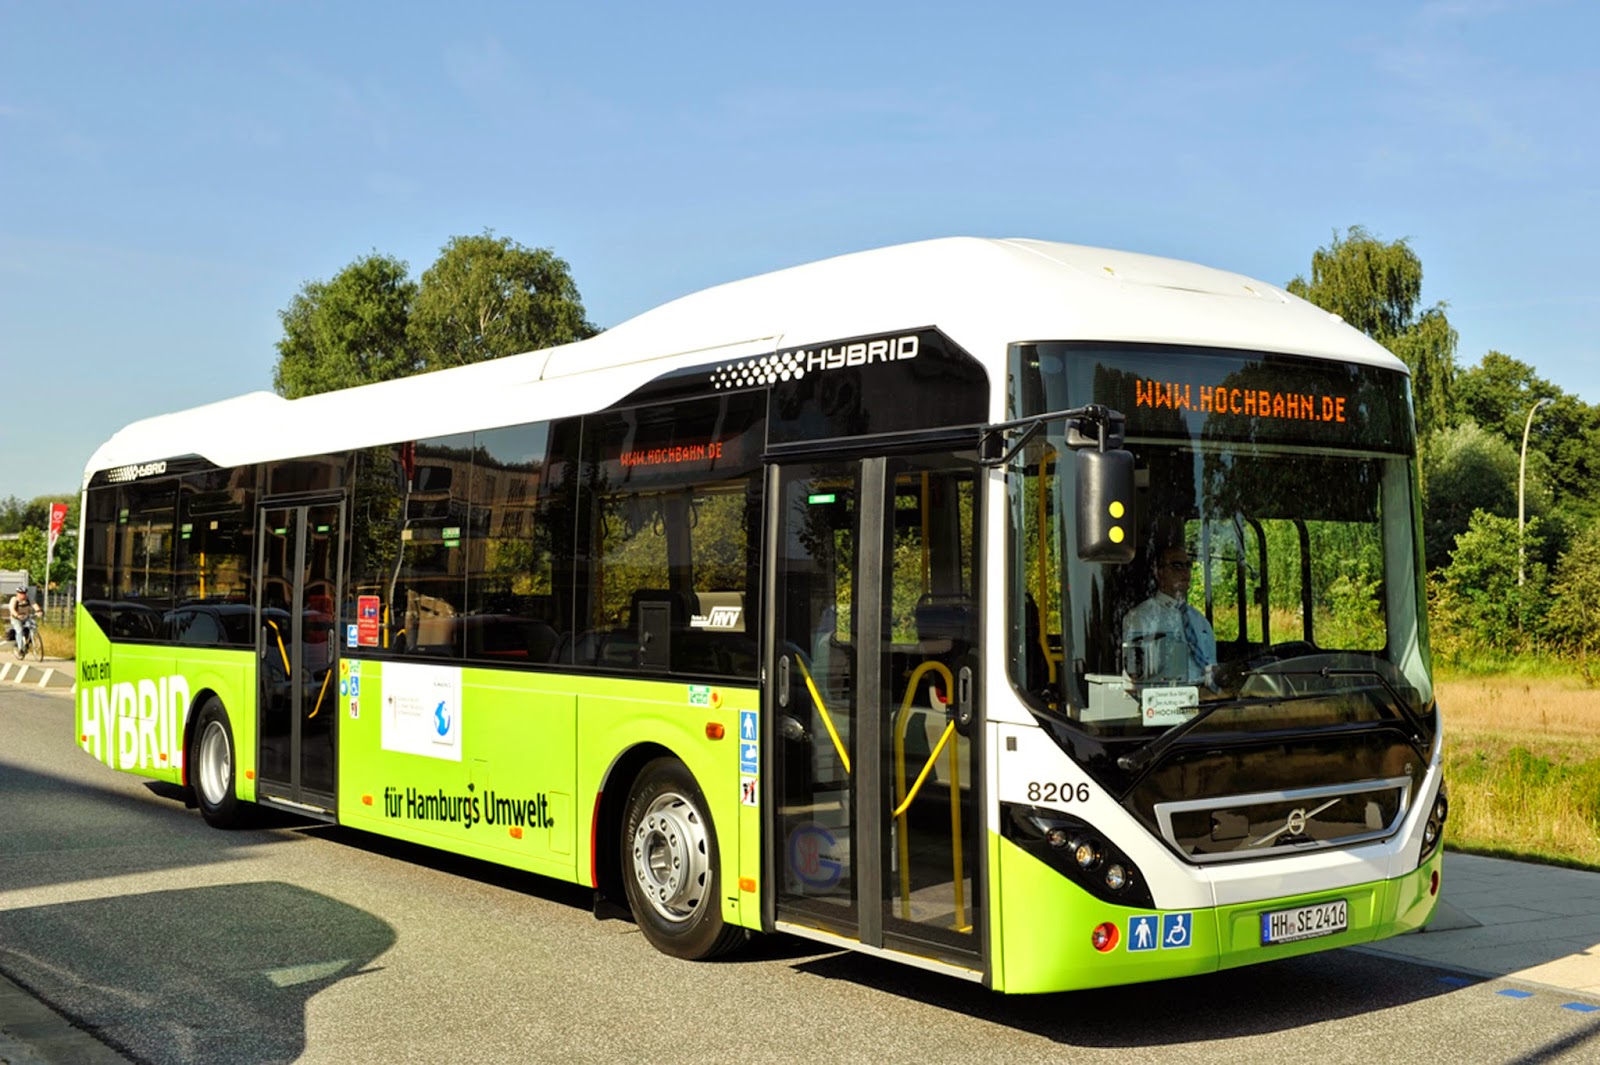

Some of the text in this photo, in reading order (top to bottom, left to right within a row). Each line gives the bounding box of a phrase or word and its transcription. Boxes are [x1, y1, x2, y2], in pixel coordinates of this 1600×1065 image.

[806, 335, 919, 372] HYBRID
[1135, 379, 1346, 422] WWW.HOCHBAHN.DE
[620, 442, 722, 466] WWW.HOCHBAHN.DE
[82, 658, 111, 682] Noch ein
[82, 674, 190, 769] HYBRID
[384, 787, 403, 818] für
[1027, 781, 1090, 803] 8206
[1271, 913, 1288, 938] HH
[1297, 909, 1313, 932] SE
[1315, 903, 1346, 929] 2416
